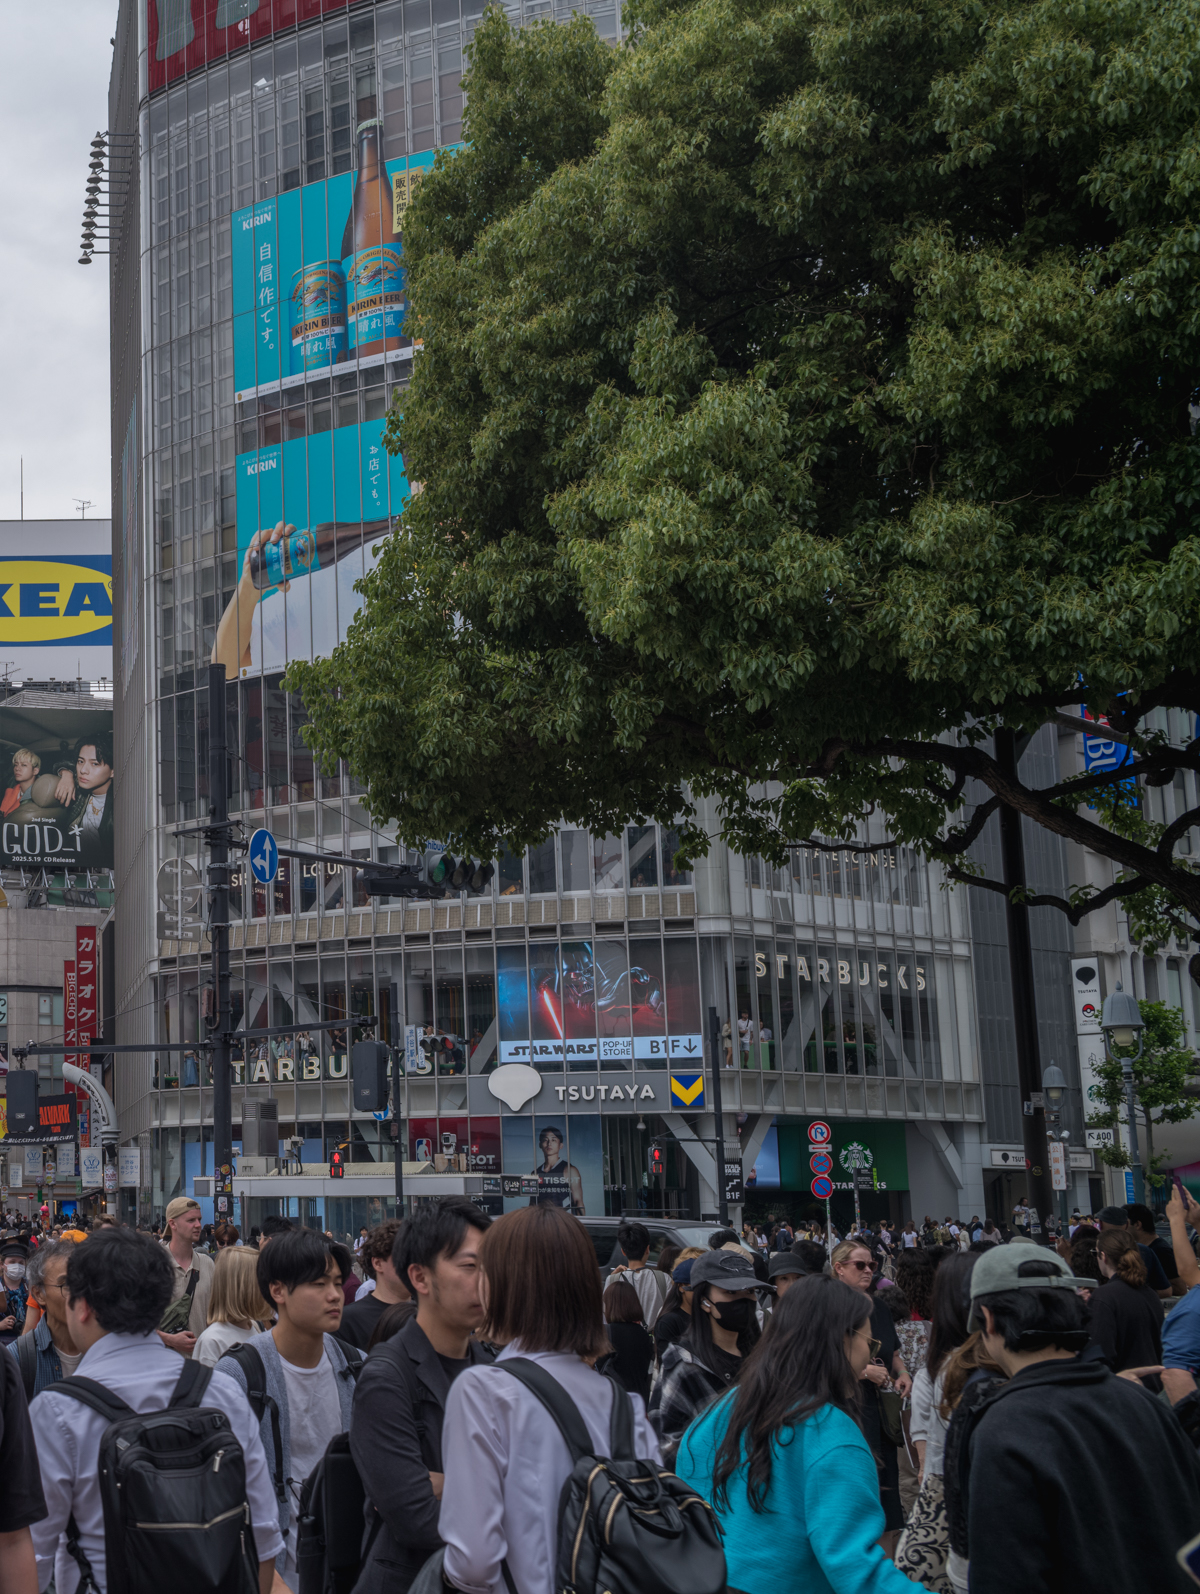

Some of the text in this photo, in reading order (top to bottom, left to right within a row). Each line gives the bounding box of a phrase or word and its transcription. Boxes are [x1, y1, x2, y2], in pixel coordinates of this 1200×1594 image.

[243, 212, 271, 231] KIRIN
[258, 242, 275, 350] 自信作です。
[351, 293, 401, 313] KIRIN BEER
[294, 315, 343, 336] KIRIN BEER
[247, 458, 277, 476] KIRIN
[369, 445, 381, 506] お店でも。
[78, 936, 96, 1022] カラオケ
[754, 952, 927, 992] STARBUCKS
[67, 973, 76, 1019] BIG ECHO
[508, 1043, 598, 1057] STAR WARS
[603, 1040, 633, 1051] POP-UP
[603, 1049, 631, 1057] STORE
[650, 1040, 681, 1055] B1F
[555, 1084, 656, 1101] TSUTAYA
[39, 1104, 71, 1126] ALVARK
[1052, 1145, 1061, 1187] 公園通り
[544, 1176, 582, 1185] TISSOT
[725, 1191, 740, 1200] B1F
